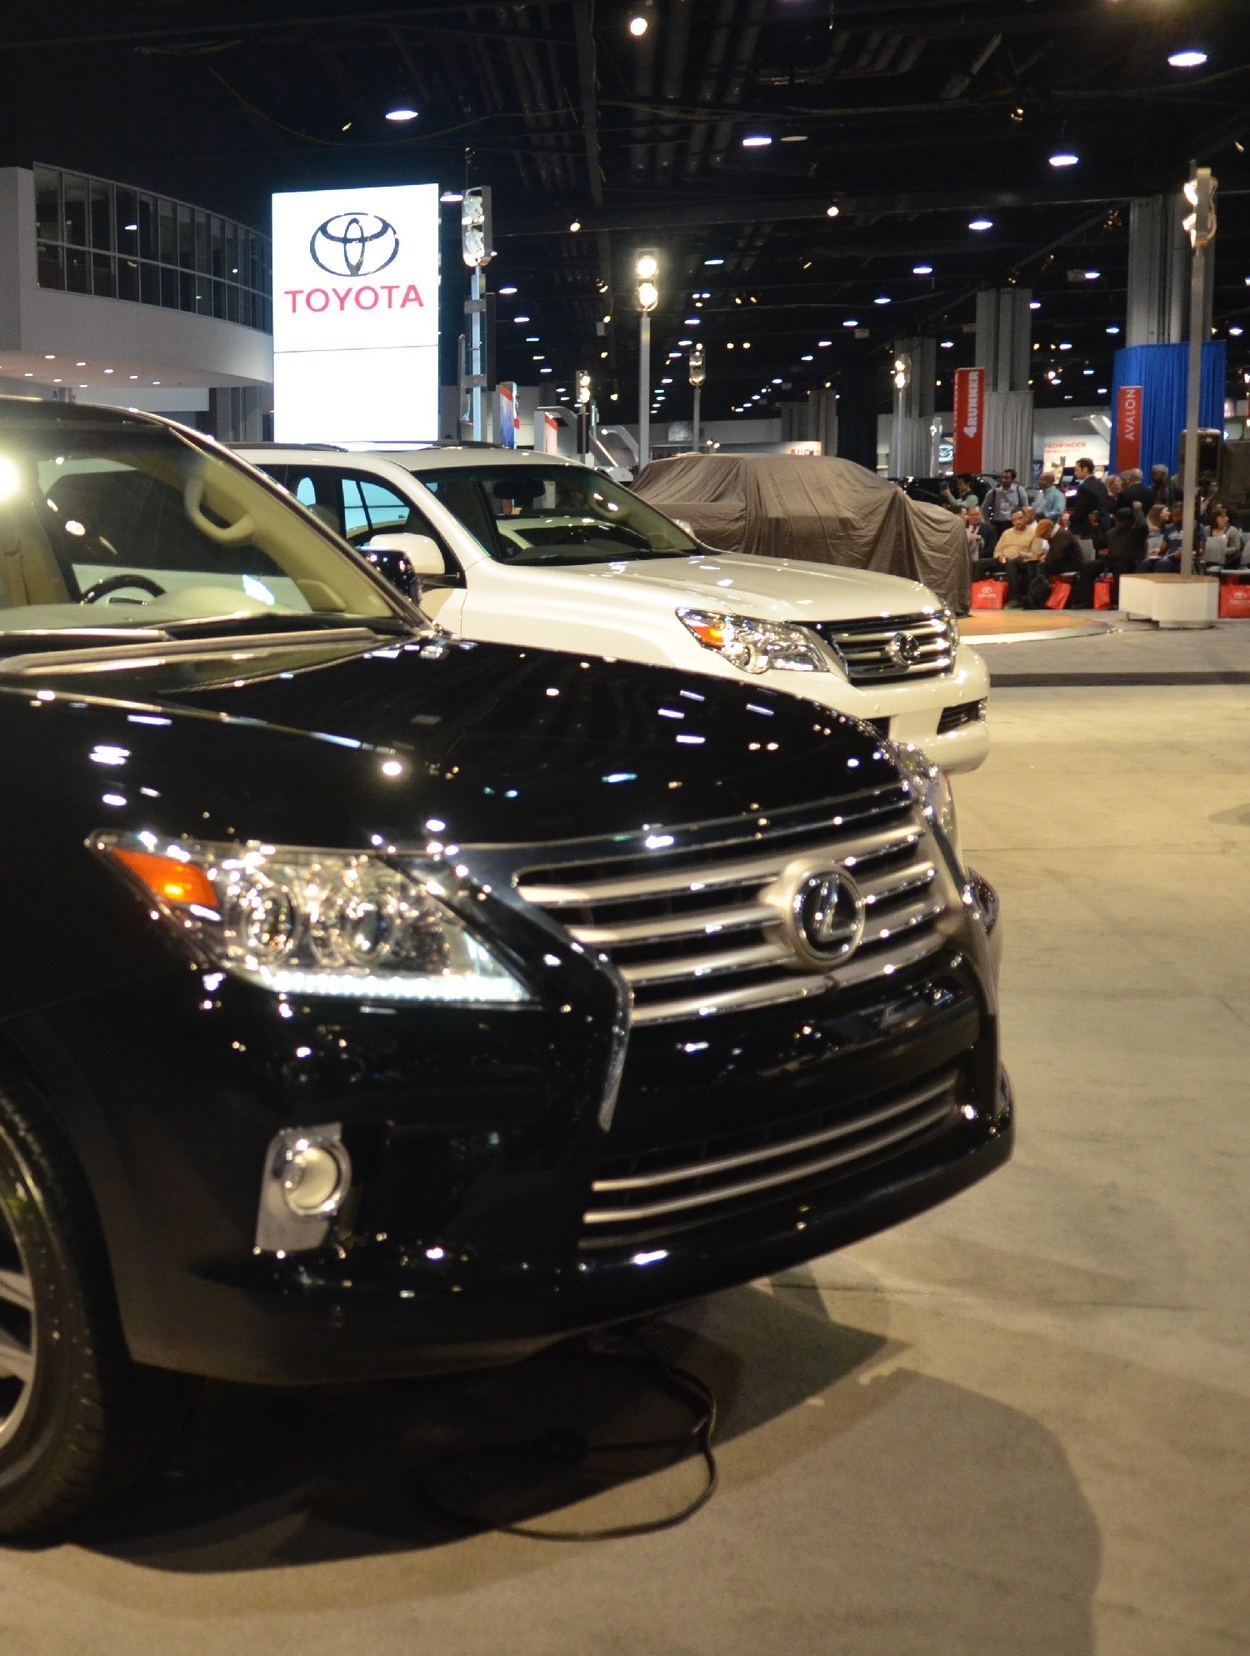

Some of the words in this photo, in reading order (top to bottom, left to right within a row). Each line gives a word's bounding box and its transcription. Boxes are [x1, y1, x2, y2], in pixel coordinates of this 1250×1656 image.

[284, 284, 424, 313] TOYOTA
[963, 371, 979, 438] 4RUNNER
[1125, 388, 1136, 440] AVALON
